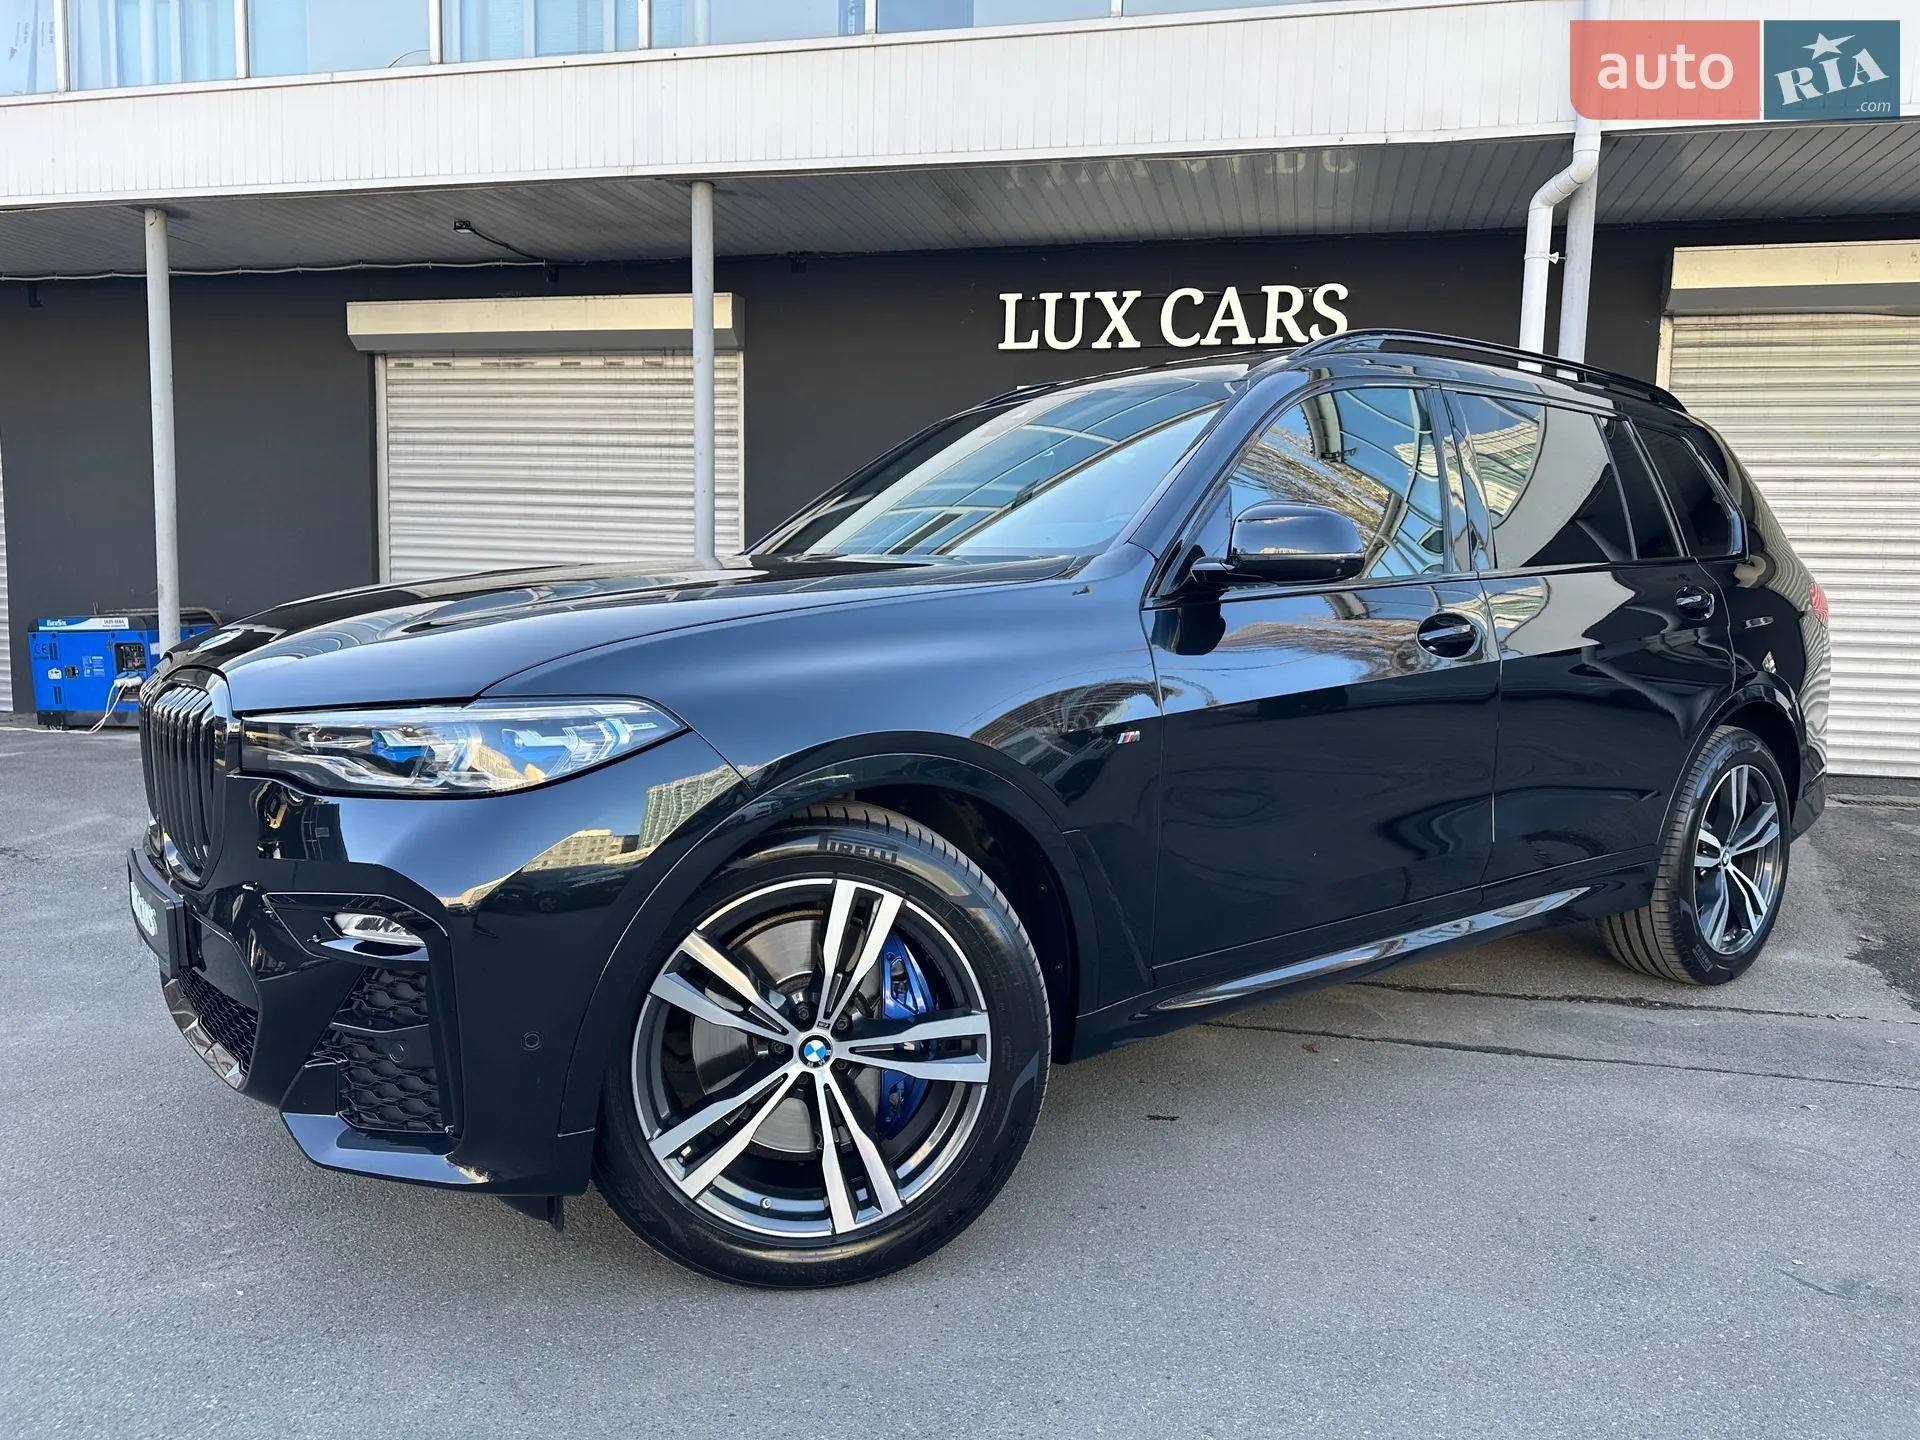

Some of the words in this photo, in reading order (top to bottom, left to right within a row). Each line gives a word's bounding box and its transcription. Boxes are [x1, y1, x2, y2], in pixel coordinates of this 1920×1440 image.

[997, 289, 1142, 350] LUX
[1160, 282, 1349, 348] CARS
[817, 833, 900, 864] PIRELLI
